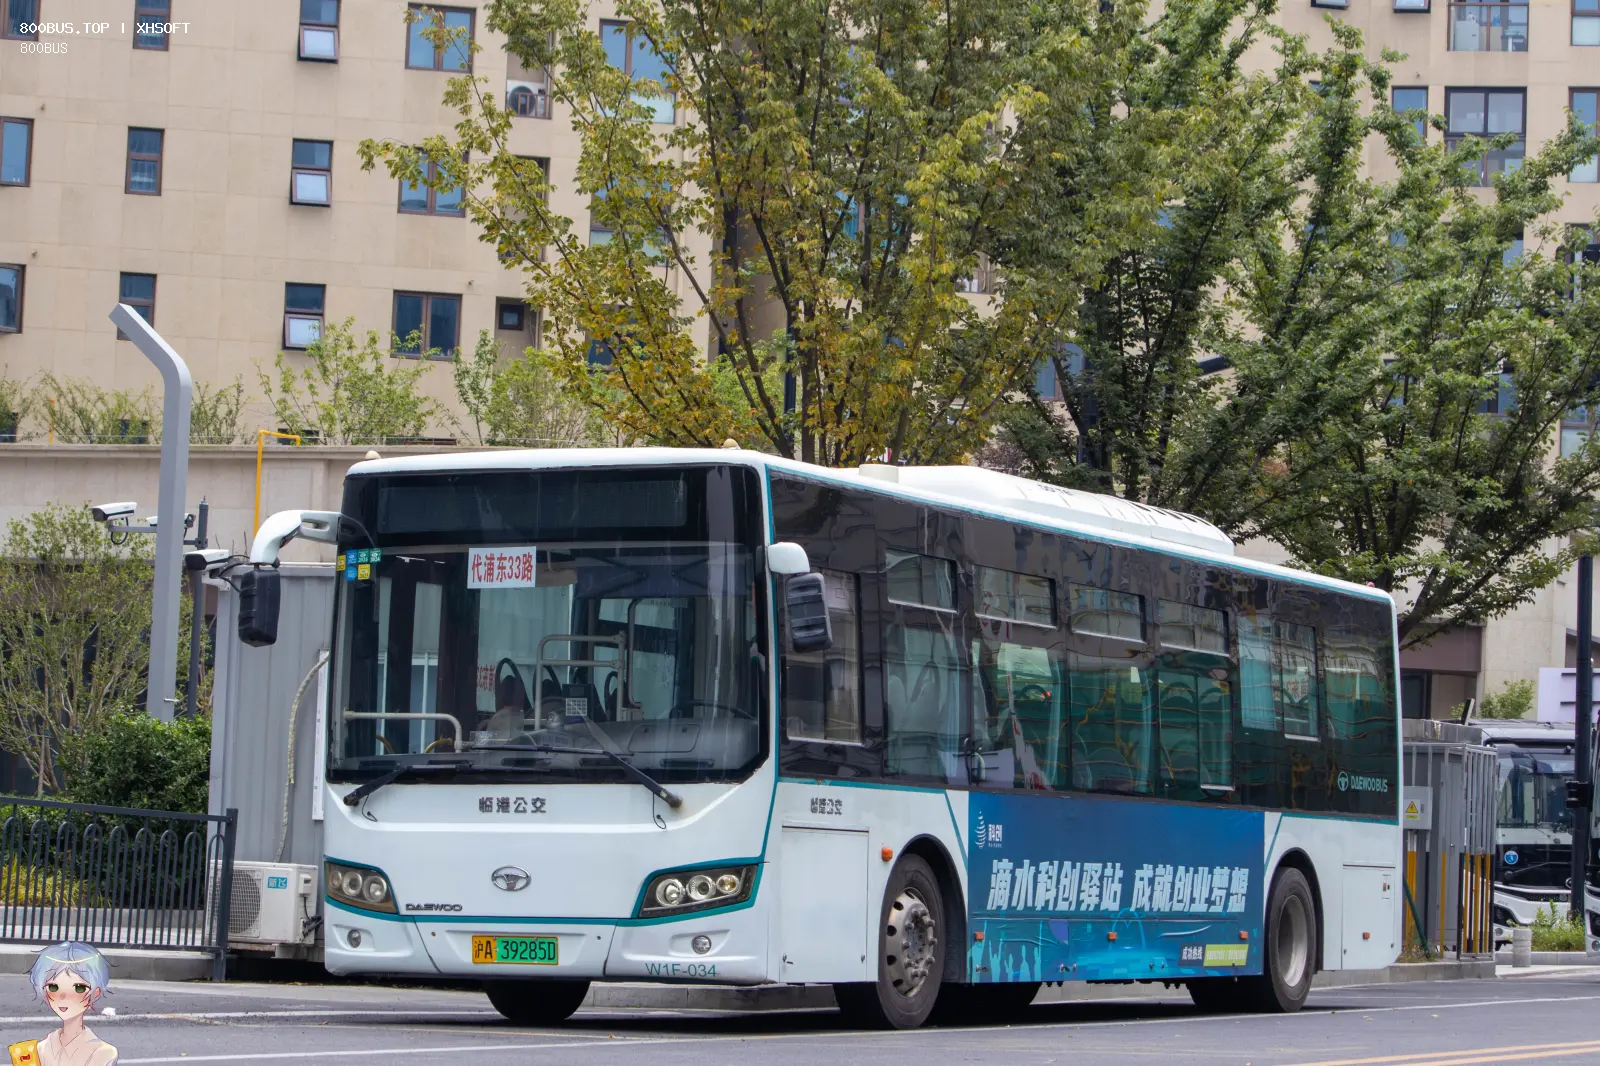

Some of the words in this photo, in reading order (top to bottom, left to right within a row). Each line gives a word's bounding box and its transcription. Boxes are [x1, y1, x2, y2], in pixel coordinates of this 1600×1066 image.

[471, 552, 534, 583] 代浦东33路
[479, 797, 546, 813] 临港公交
[986, 858, 1124, 912] 滴水科创驿站
[1130, 863, 1249, 913] 成就创业梦想
[405, 903, 463, 911] DAEWOO
[645, 963, 717, 977] W1F-034
